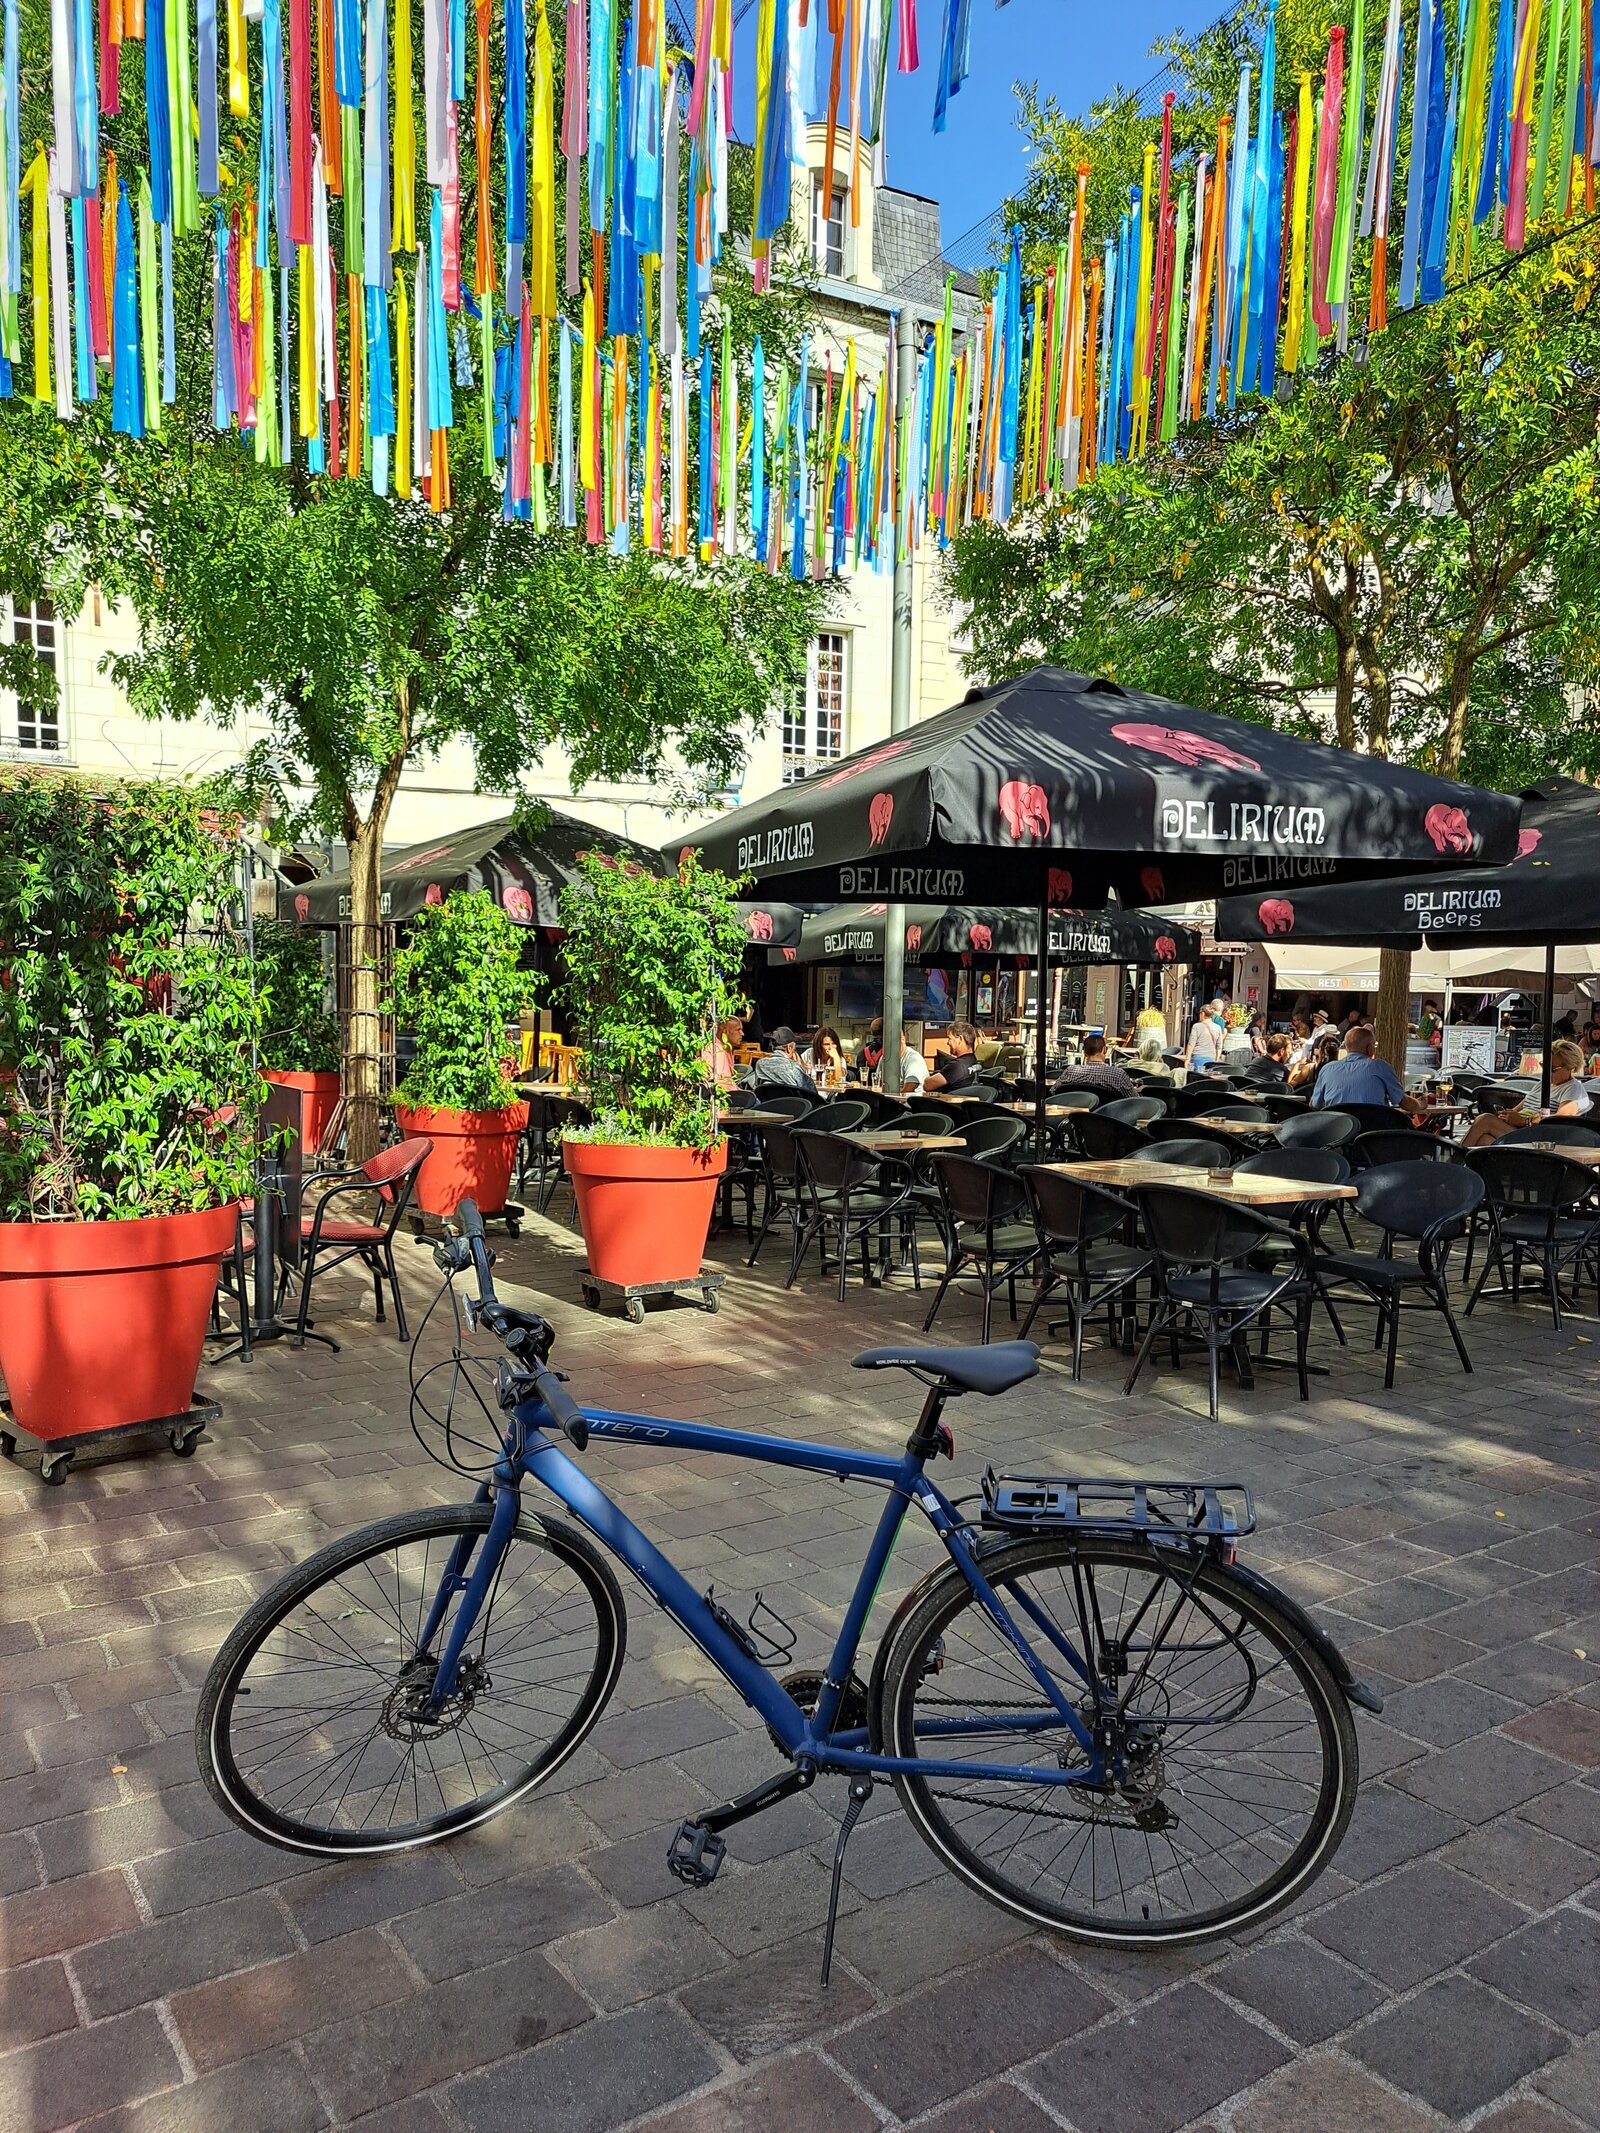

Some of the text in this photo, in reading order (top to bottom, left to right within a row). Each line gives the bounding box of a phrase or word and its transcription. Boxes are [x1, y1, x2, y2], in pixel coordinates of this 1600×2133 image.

[1162, 799, 1325, 845] DELIRIUM
[737, 821, 814, 871] DELIRIUM
[839, 866, 965, 897] DELIRIUM
[1223, 856, 1337, 888] DELIRIUM
[1404, 889, 1502, 911] DELIRIUM
[1418, 911, 1482, 929] Beers
[824, 931, 874, 952] DELIRIUM
[1047, 932, 1112, 953] ELIRIUM
[1360, 979, 1379, 988] BAR
[586, 1418, 670, 1437] NTERO
